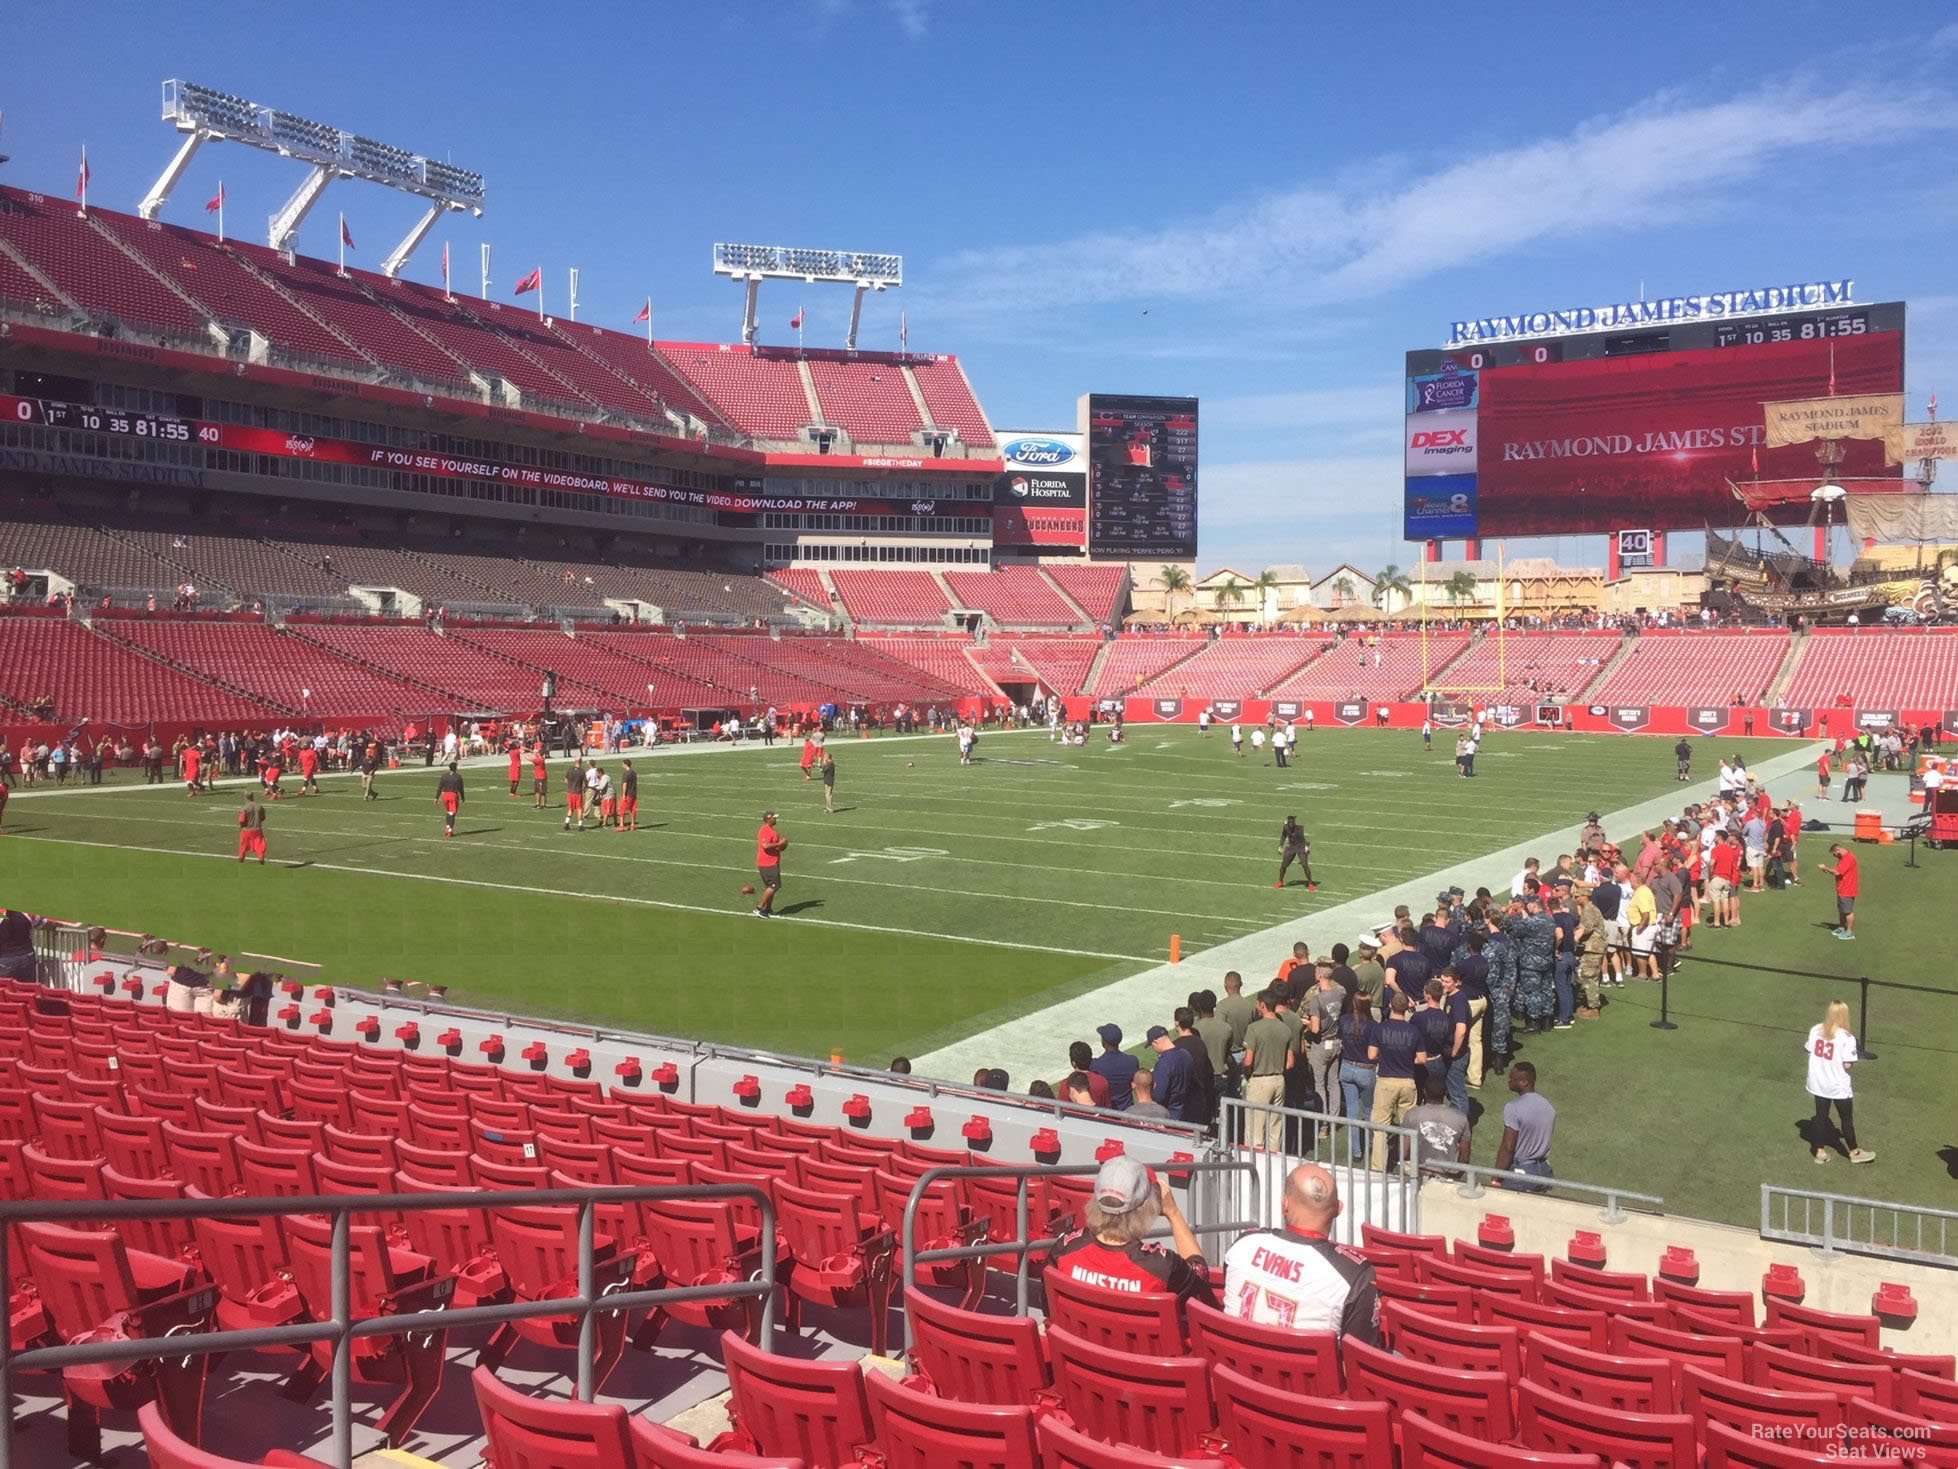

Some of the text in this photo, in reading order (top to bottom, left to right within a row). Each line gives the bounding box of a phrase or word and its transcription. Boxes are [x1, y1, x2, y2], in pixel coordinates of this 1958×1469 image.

[29, 193, 44, 203] 310
[147, 221, 162, 230] 309
[1450, 280, 1851, 344] RAYMOND JAMES STADIUM
[1772, 330, 1791, 342] 35
[1800, 319, 1866, 339] 81:55
[1720, 334, 1736, 346] 1ST
[1745, 332, 1764, 344] 10
[1472, 354, 1483, 368] 0
[1535, 348, 1547, 362] 0
[1436, 380, 1464, 390] FLORIDA
[1436, 388, 1464, 398] CANCER
[17, 402, 32, 420] 0
[48, 410, 66, 424] 1ST
[1779, 406, 1889, 422] RAYMOND JAMES
[82, 416, 100, 428] 10
[110, 418, 129, 432] 35
[1805, 420, 1859, 432] STADIUM
[136, 420, 189, 440] 81:55
[199, 427, 219, 442] 40
[1410, 429, 1468, 448] DEX
[1504, 425, 1766, 460] RAYMOND JAMES ST
[1915, 437, 1946, 446] WORLD
[1016, 442, 1060, 462] Ford
[863, 458, 923, 468] #SIEGETHEDAY
[371, 450, 856, 510] IF YOU SEE YOURSELF ON THE VIDEOBOARD, WE'LL SEND YOU THE VIDEO. DOWNLOAD THE APP!
[1031, 480, 1066, 488] FLORIDA
[1031, 488, 1071, 498] HOSPITAL
[1450, 494, 1468, 512] 8
[1024, 519, 1084, 532] BUCCANEERS
[1621, 533, 1646, 550] 40
[1382, 1026, 1412, 1046] NAVY
[1814, 1039, 1834, 1060] 83
[1251, 1246, 1304, 1283] EVANS
[1072, 1265, 1141, 1292] WINSTON
